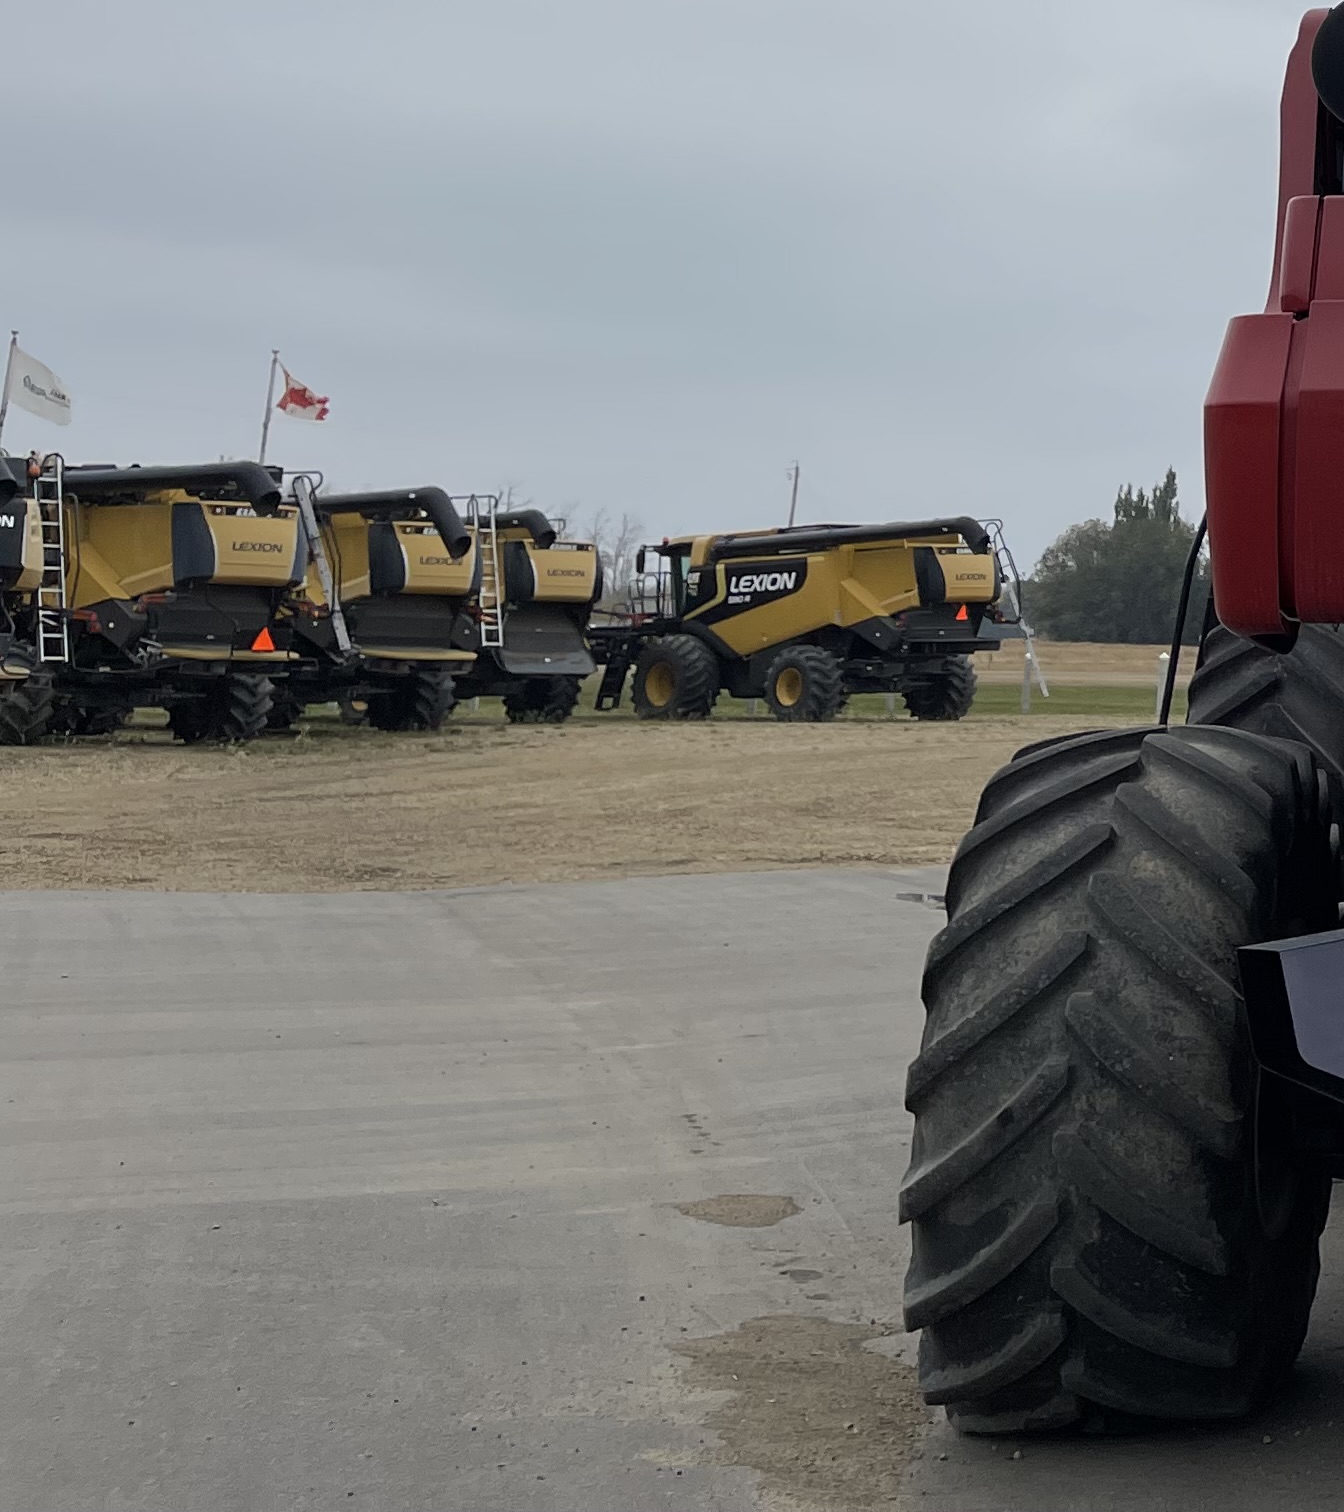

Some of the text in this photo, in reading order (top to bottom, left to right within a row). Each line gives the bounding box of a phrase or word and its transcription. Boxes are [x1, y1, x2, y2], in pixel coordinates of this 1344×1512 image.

[232, 542, 283, 553] LEXION
[547, 569, 585, 577] LEXION
[730, 572, 796, 593] LEXION
